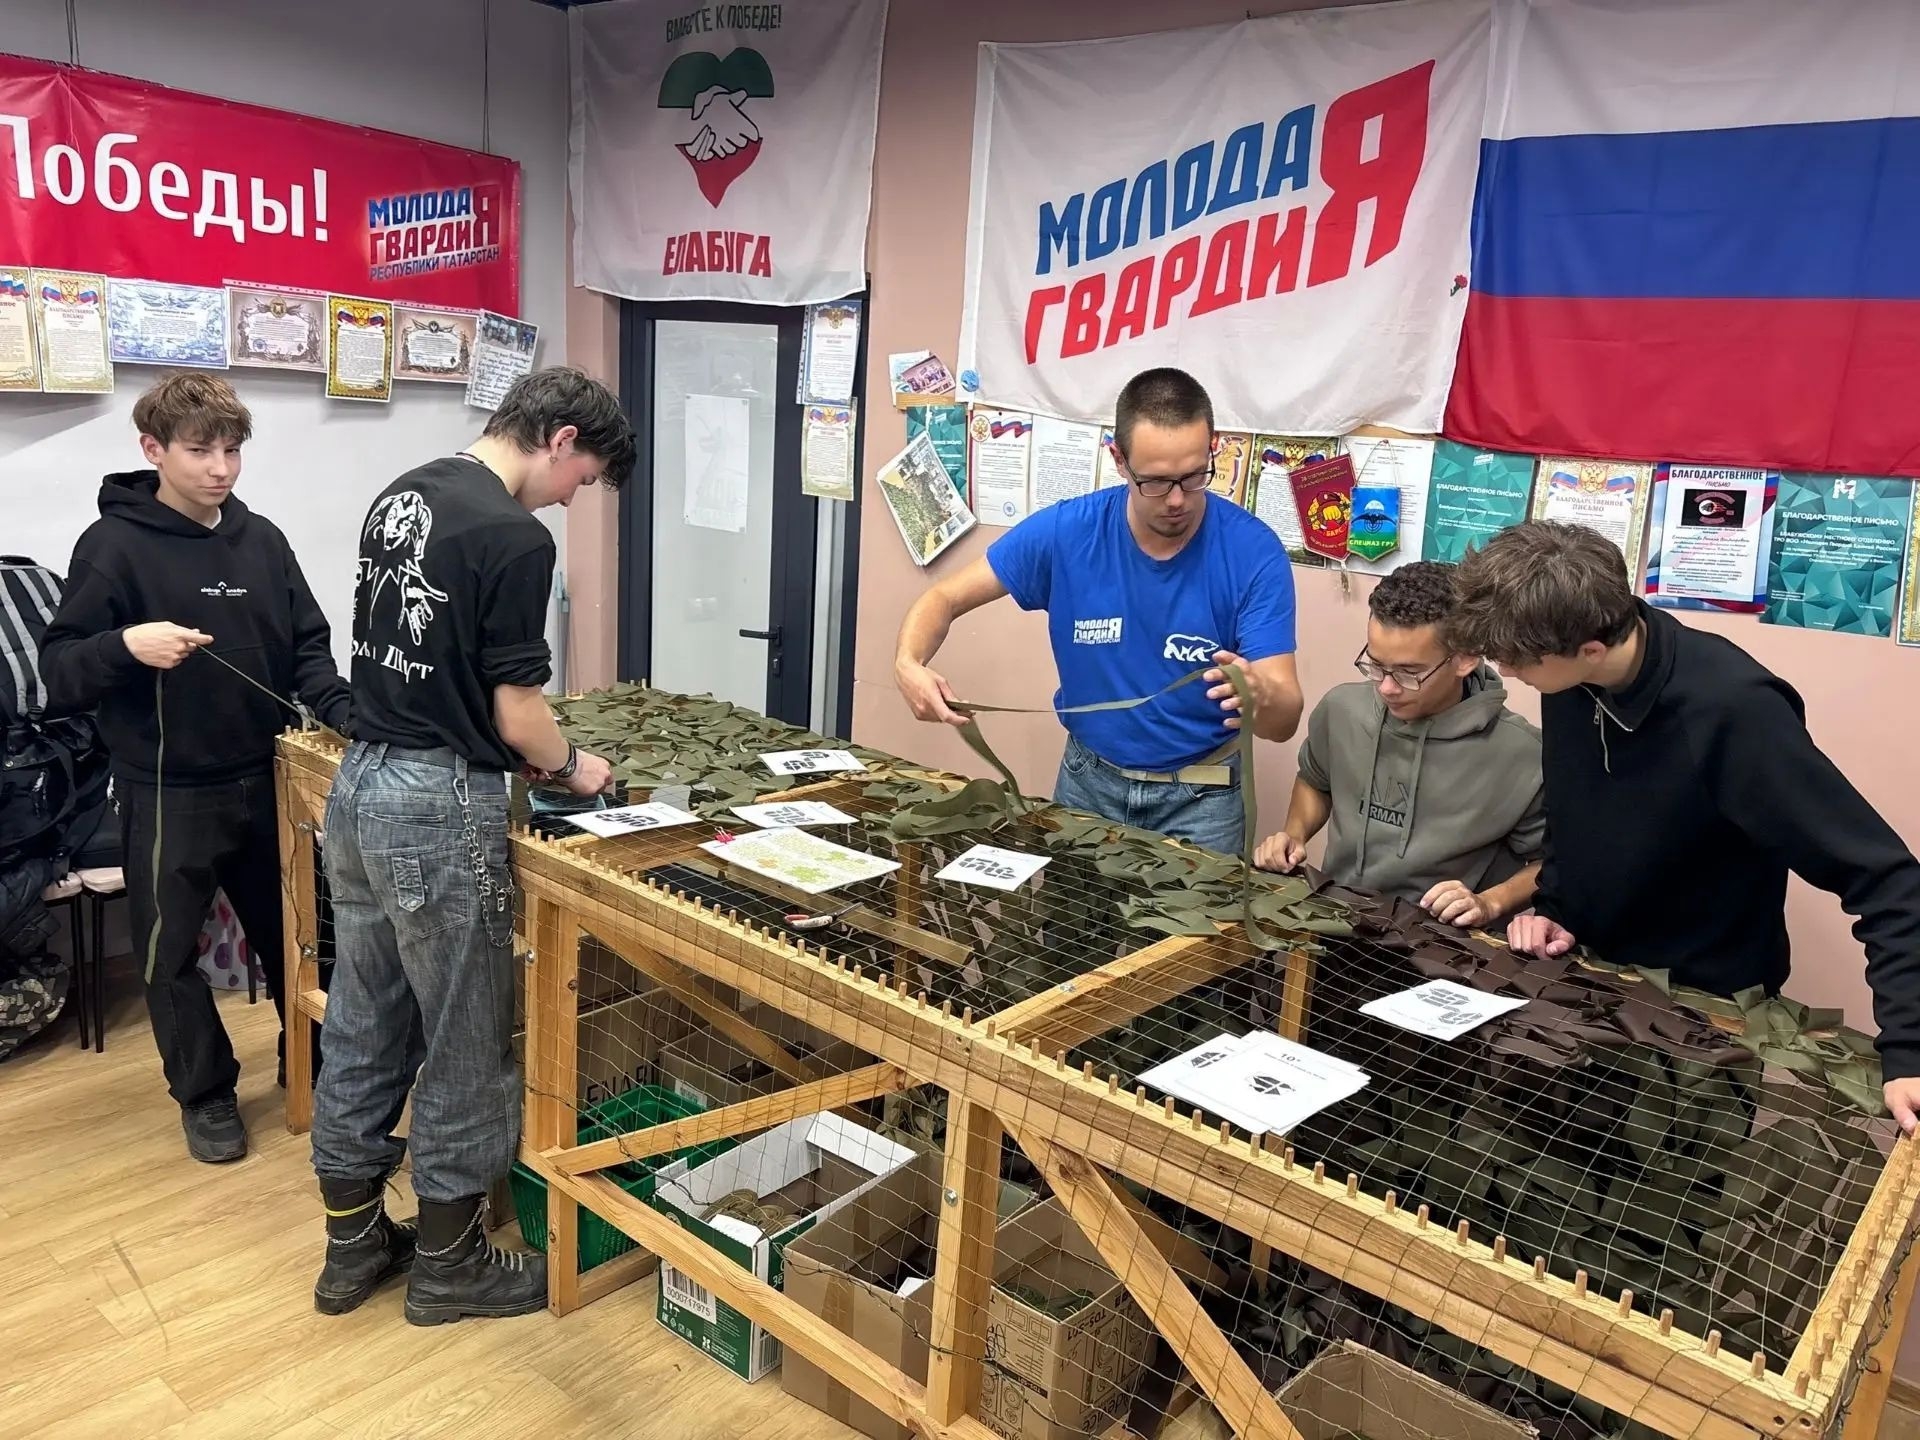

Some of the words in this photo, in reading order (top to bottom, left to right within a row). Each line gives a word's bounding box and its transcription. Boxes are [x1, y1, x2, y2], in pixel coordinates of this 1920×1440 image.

[716, 5, 725, 29] К
[727, 4, 782, 32] ПОБЕДЕ!
[370, 257, 440, 281] РЕСПУБЛИКИ
[443, 246, 500, 269] ТАТАРСТАН
[662, 230, 772, 278] ЕЛАБУГА
[1671, 469, 1764, 481] БЛАГОДАРСТВЕННОЕ
[1782, 511, 1863, 524] БЛАГОДАРСТВЕННОЕ
[1863, 517, 1899, 526] ПИСЬМО
